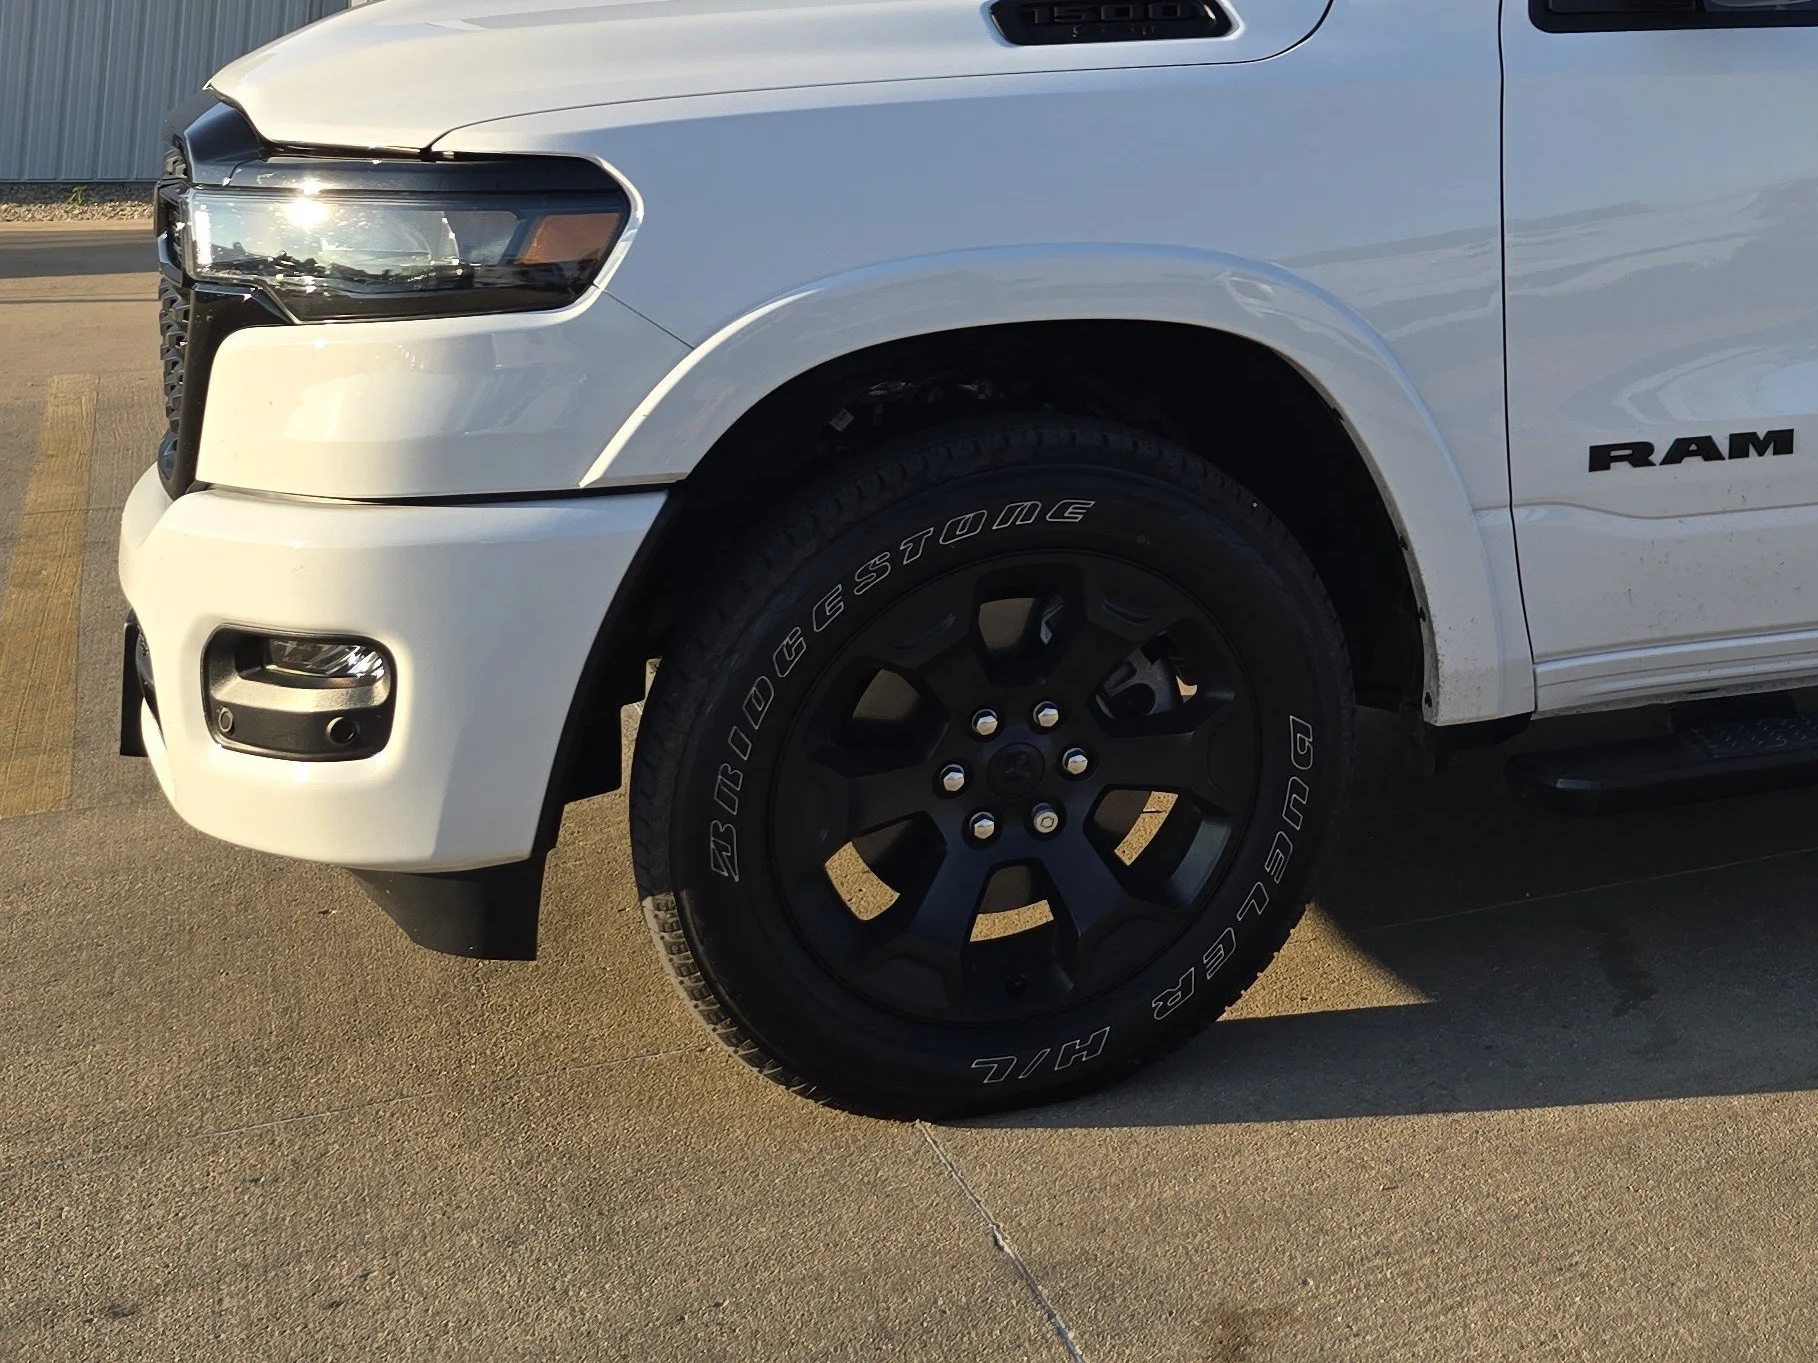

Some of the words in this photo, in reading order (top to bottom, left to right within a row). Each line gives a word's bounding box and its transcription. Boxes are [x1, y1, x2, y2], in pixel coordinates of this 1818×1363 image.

[1032, 0, 1193, 25] 1500
[1588, 429, 1794, 472] RAM
[709, 498, 1096, 883] BRIDGESTONE
[1151, 715, 1313, 1021] DUELER
[971, 1025, 1112, 1084] H/L
